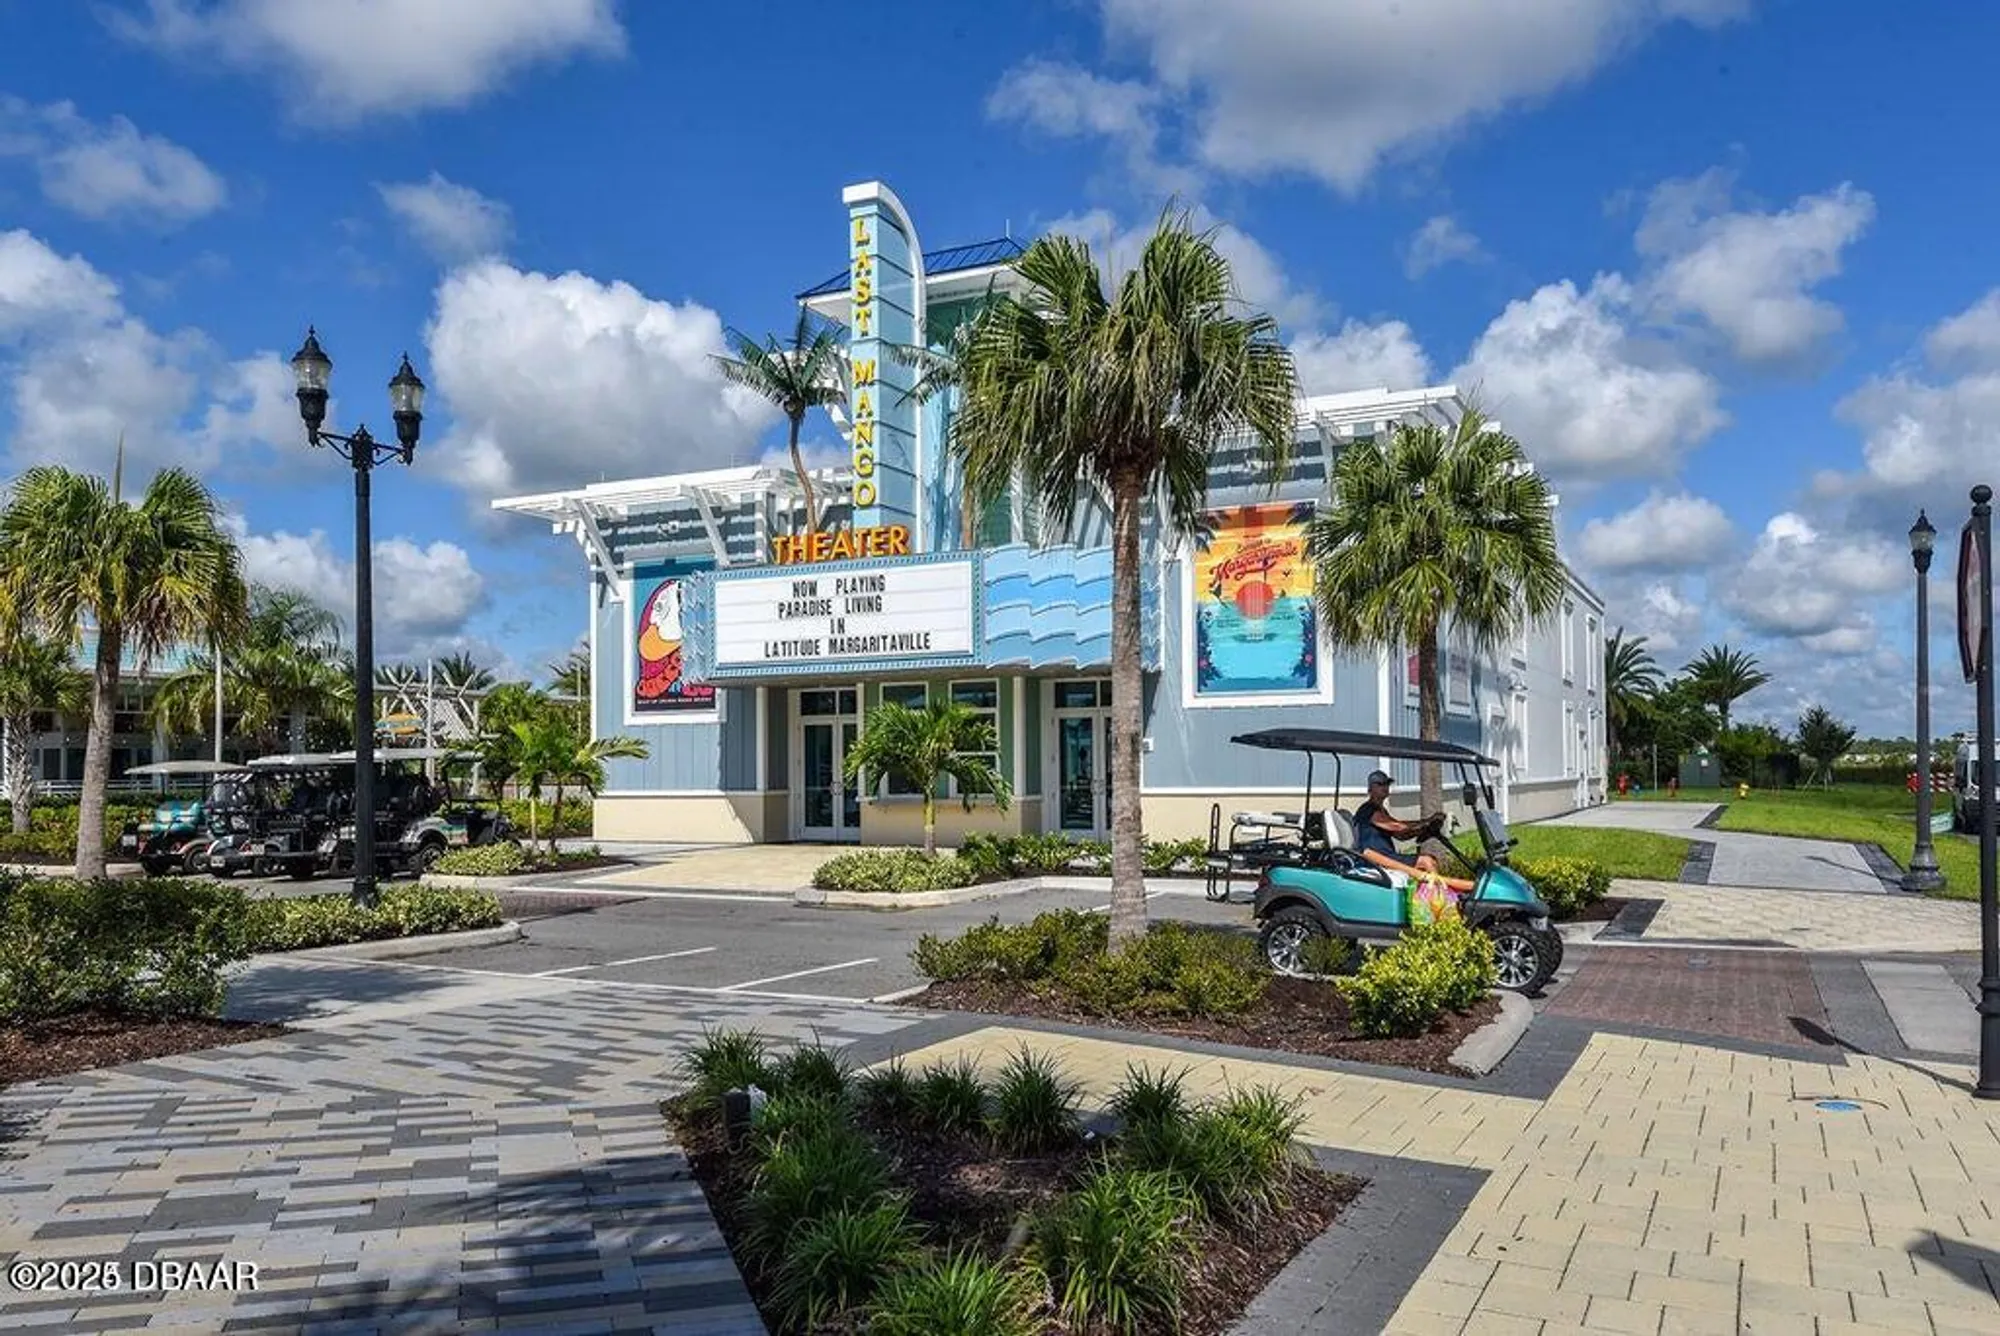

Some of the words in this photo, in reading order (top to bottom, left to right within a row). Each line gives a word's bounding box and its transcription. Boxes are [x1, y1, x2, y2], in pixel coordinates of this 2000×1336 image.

[854, 218, 872, 336] LAST
[853, 359, 877, 508] MANGO
[773, 525, 910, 565] THEATER
[793, 580, 818, 597] NOW
[836, 574, 886, 595] PLAYING
[778, 599, 832, 619] PARADISE
[845, 595, 883, 614] LIVING
[830, 617, 846, 634] IN
[764, 639, 820, 658] LATITUDE
[828, 632, 931, 654] MARGARITAVILLE
